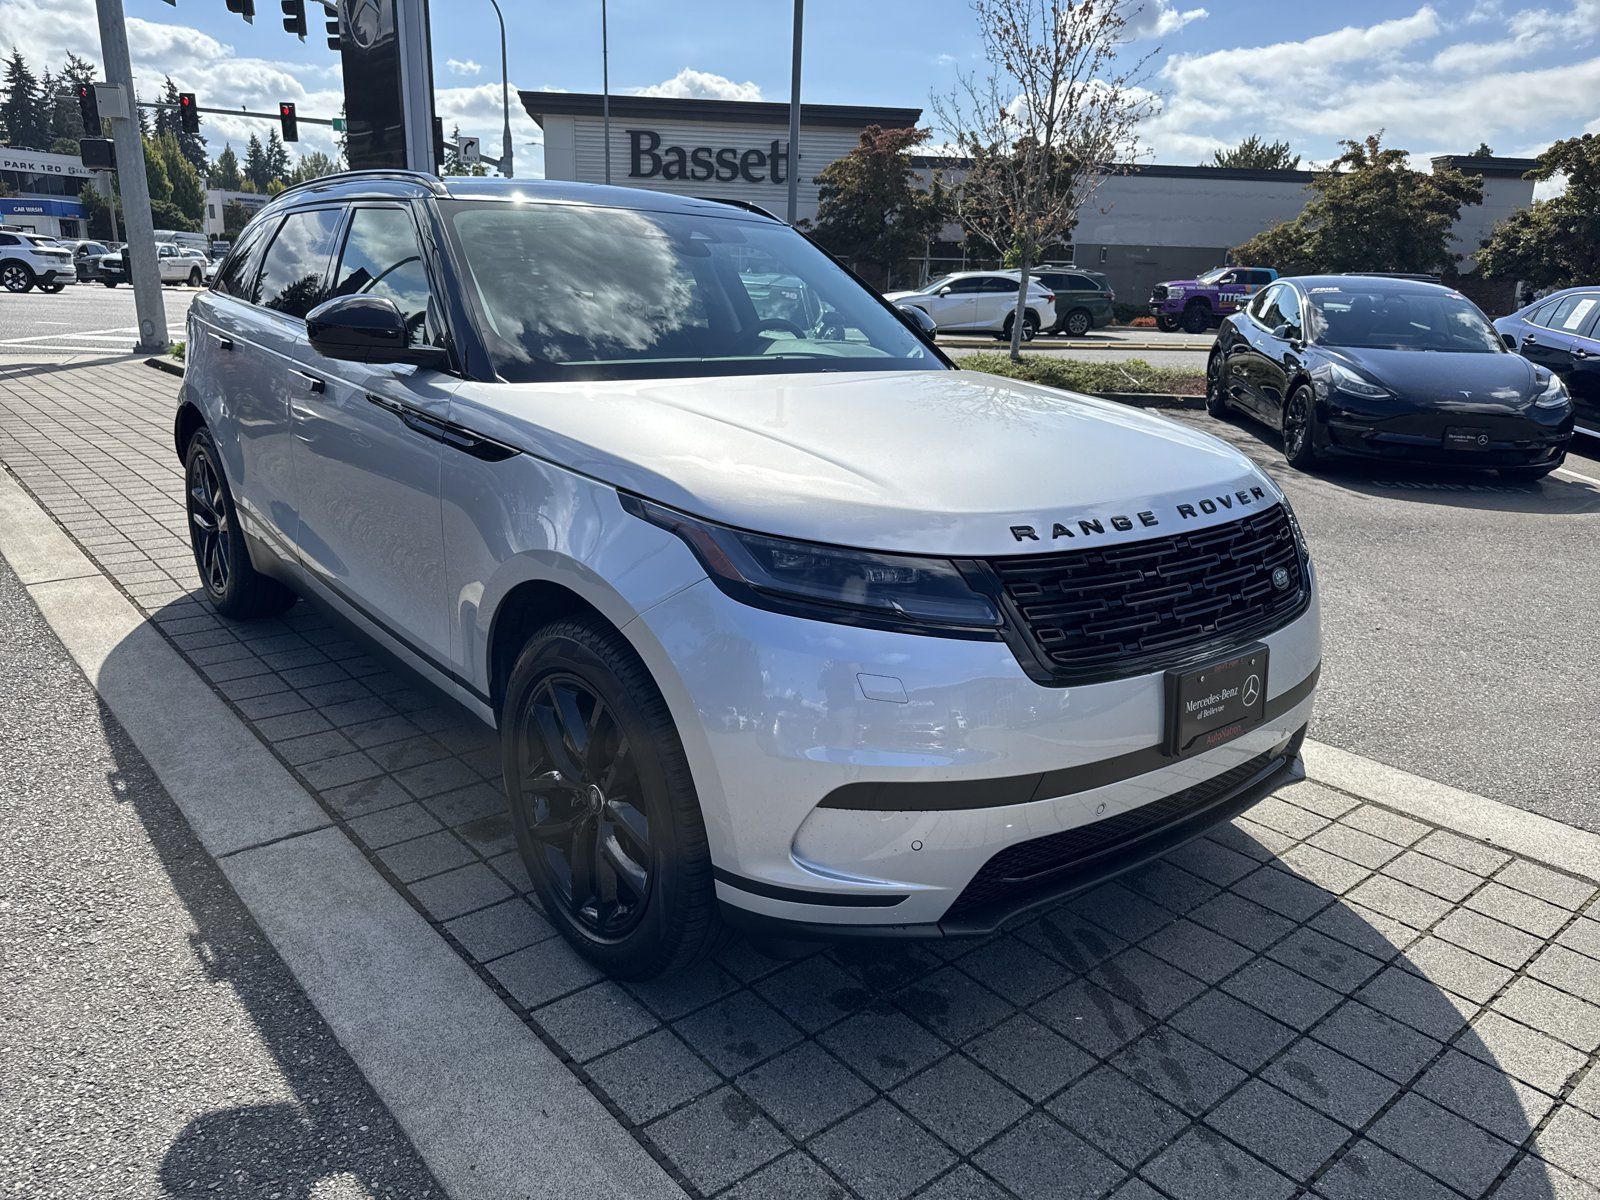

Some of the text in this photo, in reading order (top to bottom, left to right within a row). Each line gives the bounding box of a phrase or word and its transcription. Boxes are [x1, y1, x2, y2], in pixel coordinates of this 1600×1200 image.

[3, 160, 36, 170] PARK
[40, 164, 62, 173] 120
[1009, 486, 1266, 542] RANGE ROVER
[1185, 686, 1239, 713] Mercedes-Benz
[1203, 704, 1226, 719] Bellevue
